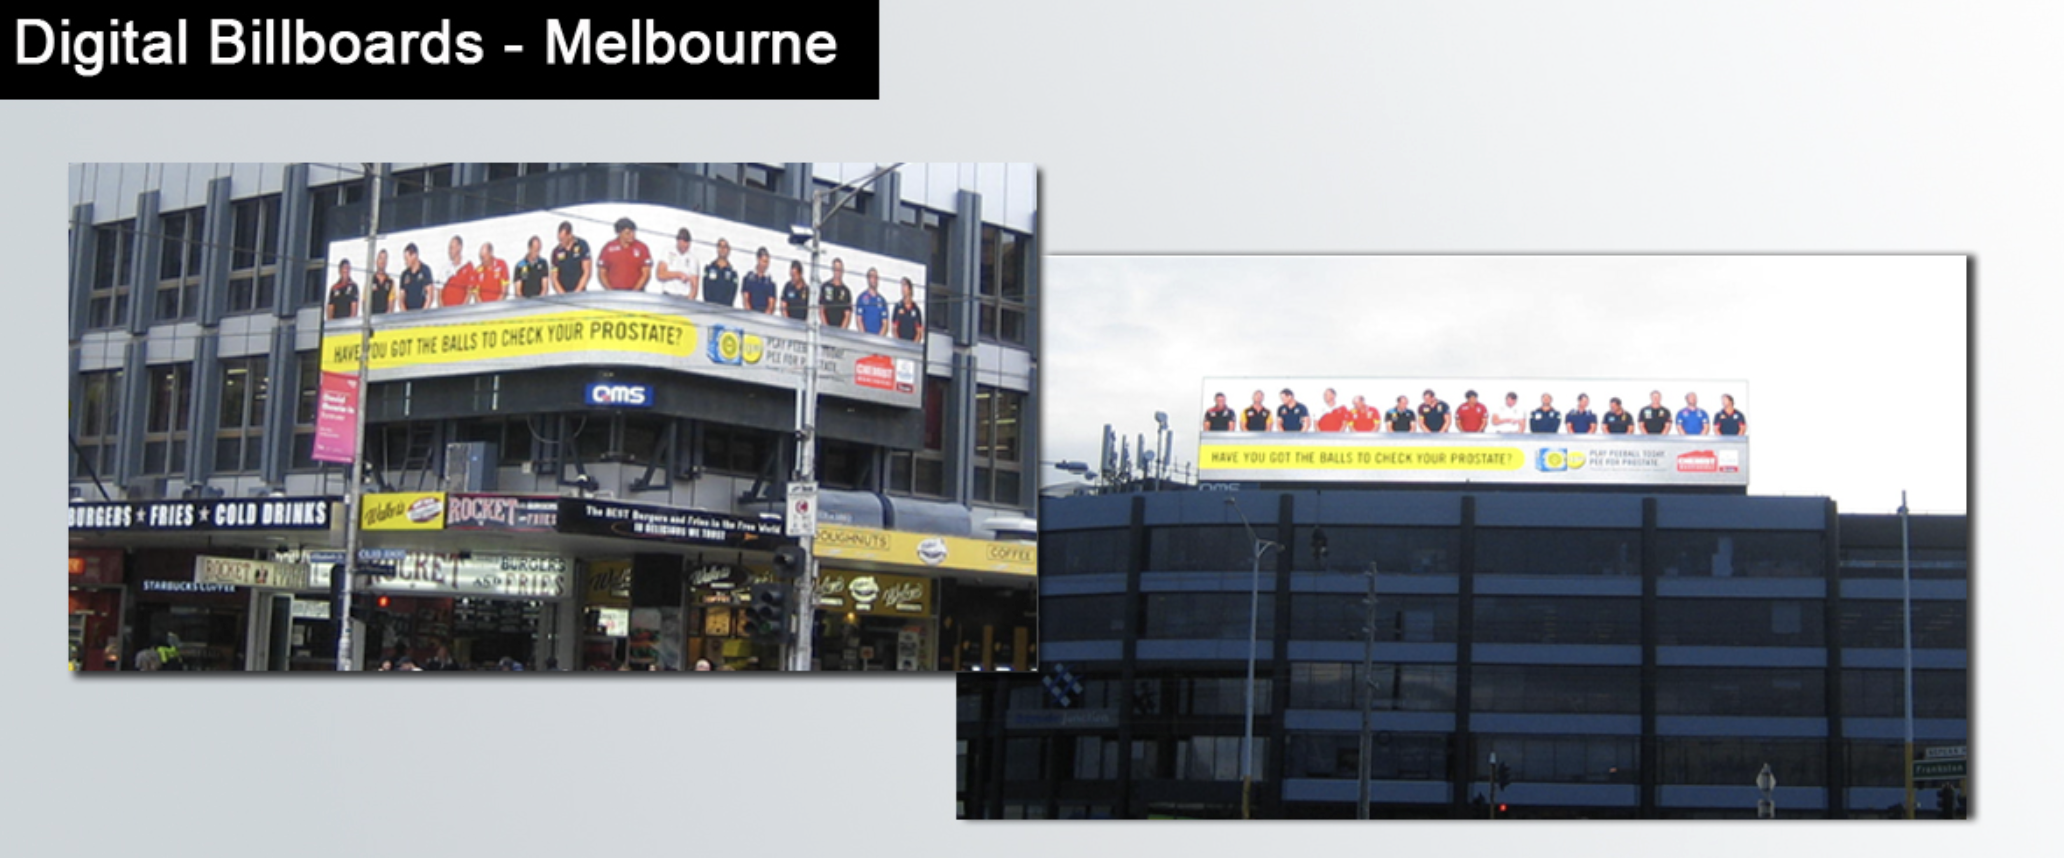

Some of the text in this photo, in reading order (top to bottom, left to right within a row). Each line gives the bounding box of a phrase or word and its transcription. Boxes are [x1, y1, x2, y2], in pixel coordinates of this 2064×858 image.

[333, 343, 361, 363] HAVE
[390, 337, 413, 359] GOT
[417, 336, 438, 355] THE
[441, 332, 477, 353] BALLS
[482, 330, 498, 348] TO
[501, 326, 543, 347] CHECK
[547, 322, 583, 342] YOUR
[590, 321, 683, 346] PROSTATE?
[1211, 451, 1513, 466] HAVE YOU GOT THE BALLS TO CHECK YOUR PROSTATE?
[69, 502, 327, 528] BURGERS FRIES COLD DRINKS
[447, 497, 518, 526] ROCKET
[586, 505, 604, 517] The
[605, 507, 630, 519] BEST
[632, 509, 668, 523] Burgers
[670, 512, 686, 525] and
[722, 517, 736, 530] the
[758, 522, 782, 535] World
[702, 528, 727, 541] TRUST
[501, 556, 566, 573] BURGERS
[990, 547, 1031, 561] COFFEE
[205, 559, 252, 583] ROCKET
[143, 580, 198, 591] STARBUCKS
[505, 573, 565, 597] FRIES
